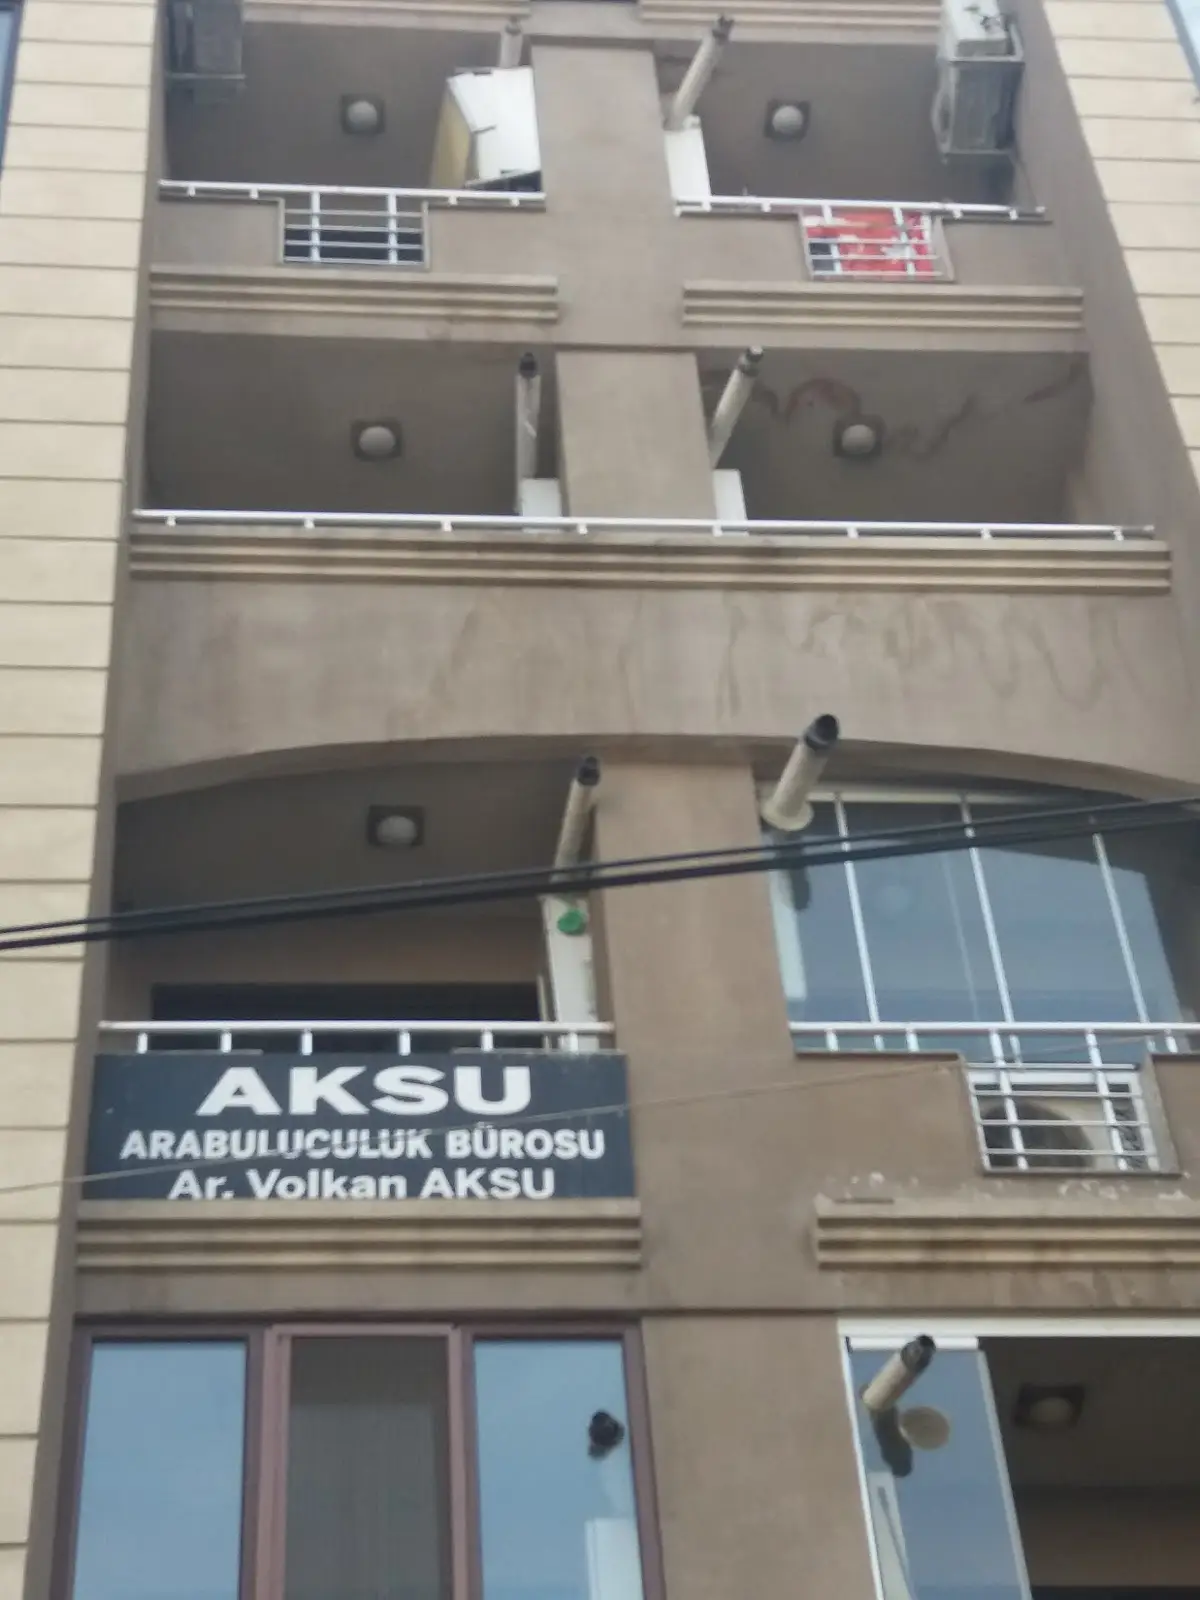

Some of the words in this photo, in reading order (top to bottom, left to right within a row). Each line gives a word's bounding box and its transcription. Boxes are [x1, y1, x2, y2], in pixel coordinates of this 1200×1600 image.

[195, 1066, 532, 1117] AKSU
[119, 1129, 433, 1160] ARABULUCULUK
[445, 1123, 605, 1159] BÜROSU
[167, 1169, 234, 1200] Ar.
[248, 1168, 406, 1200] Volkan
[419, 1168, 555, 1199] AKSU
